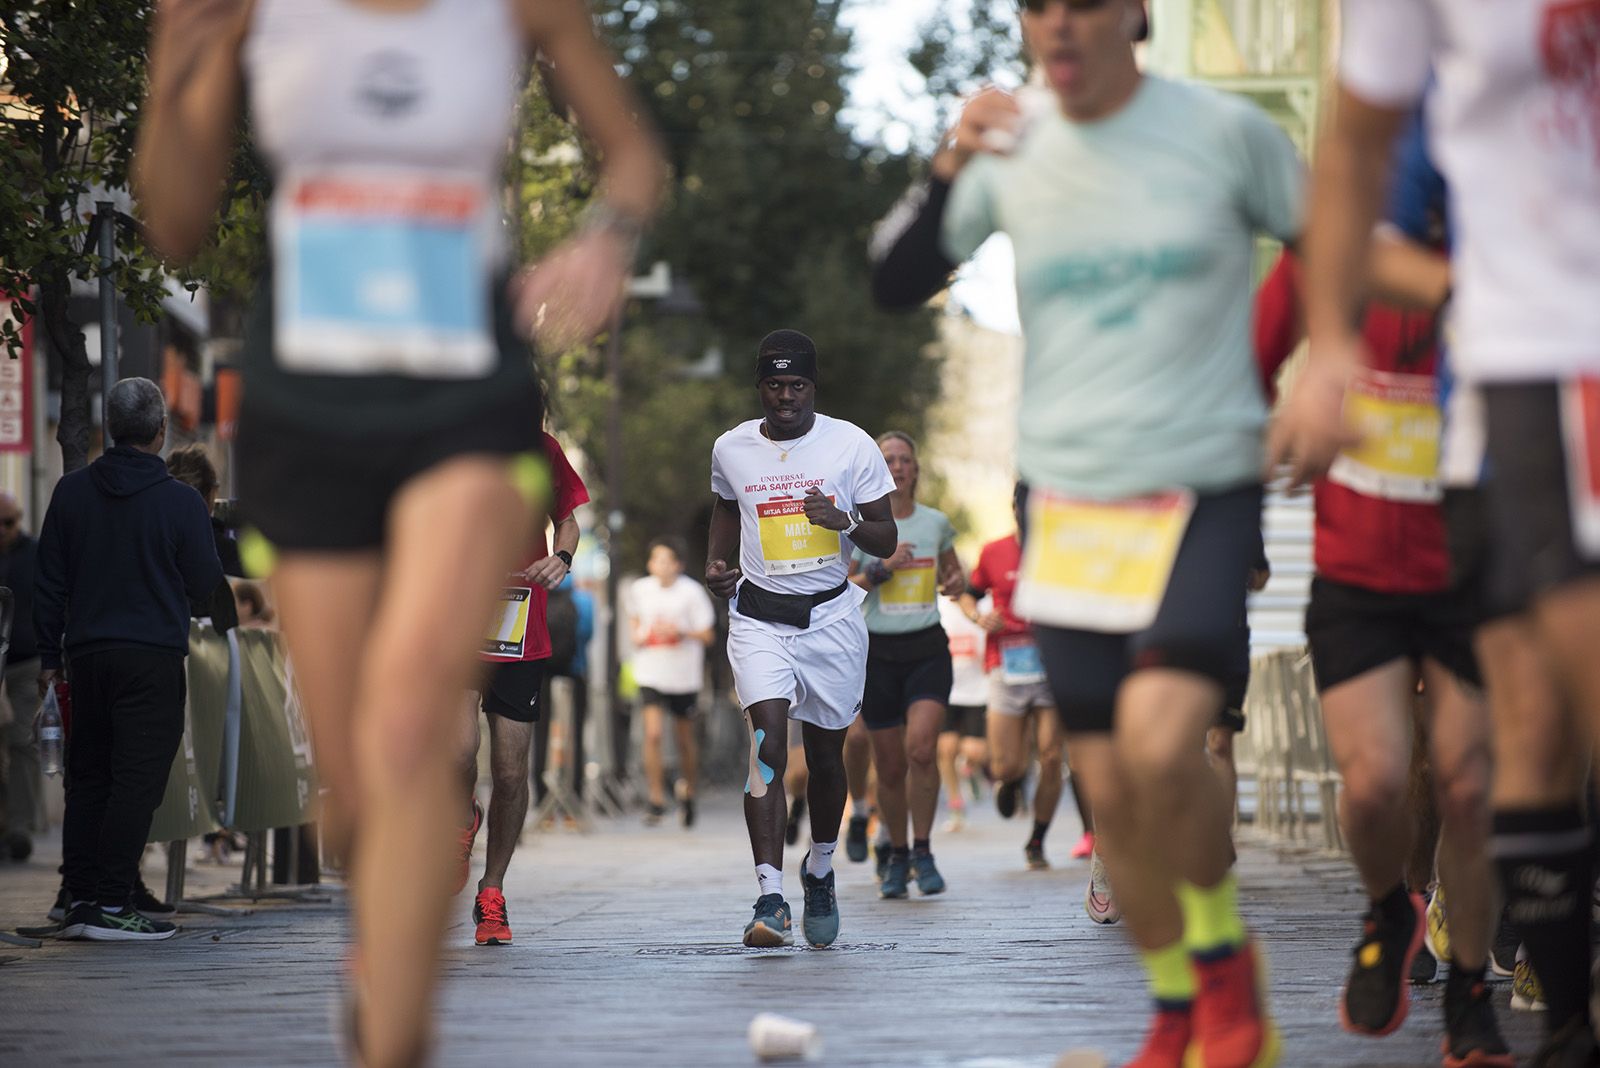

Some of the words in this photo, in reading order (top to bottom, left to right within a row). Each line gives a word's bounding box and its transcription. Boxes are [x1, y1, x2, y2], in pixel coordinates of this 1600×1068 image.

[760, 473, 805, 482] UNIVERSAE
[744, 484, 767, 493] MITJA
[770, 482, 793, 491] SANT
[793, 479, 824, 488] CUGAT
[763, 508, 781, 516] MITJA
[784, 522, 812, 537] MAEL
